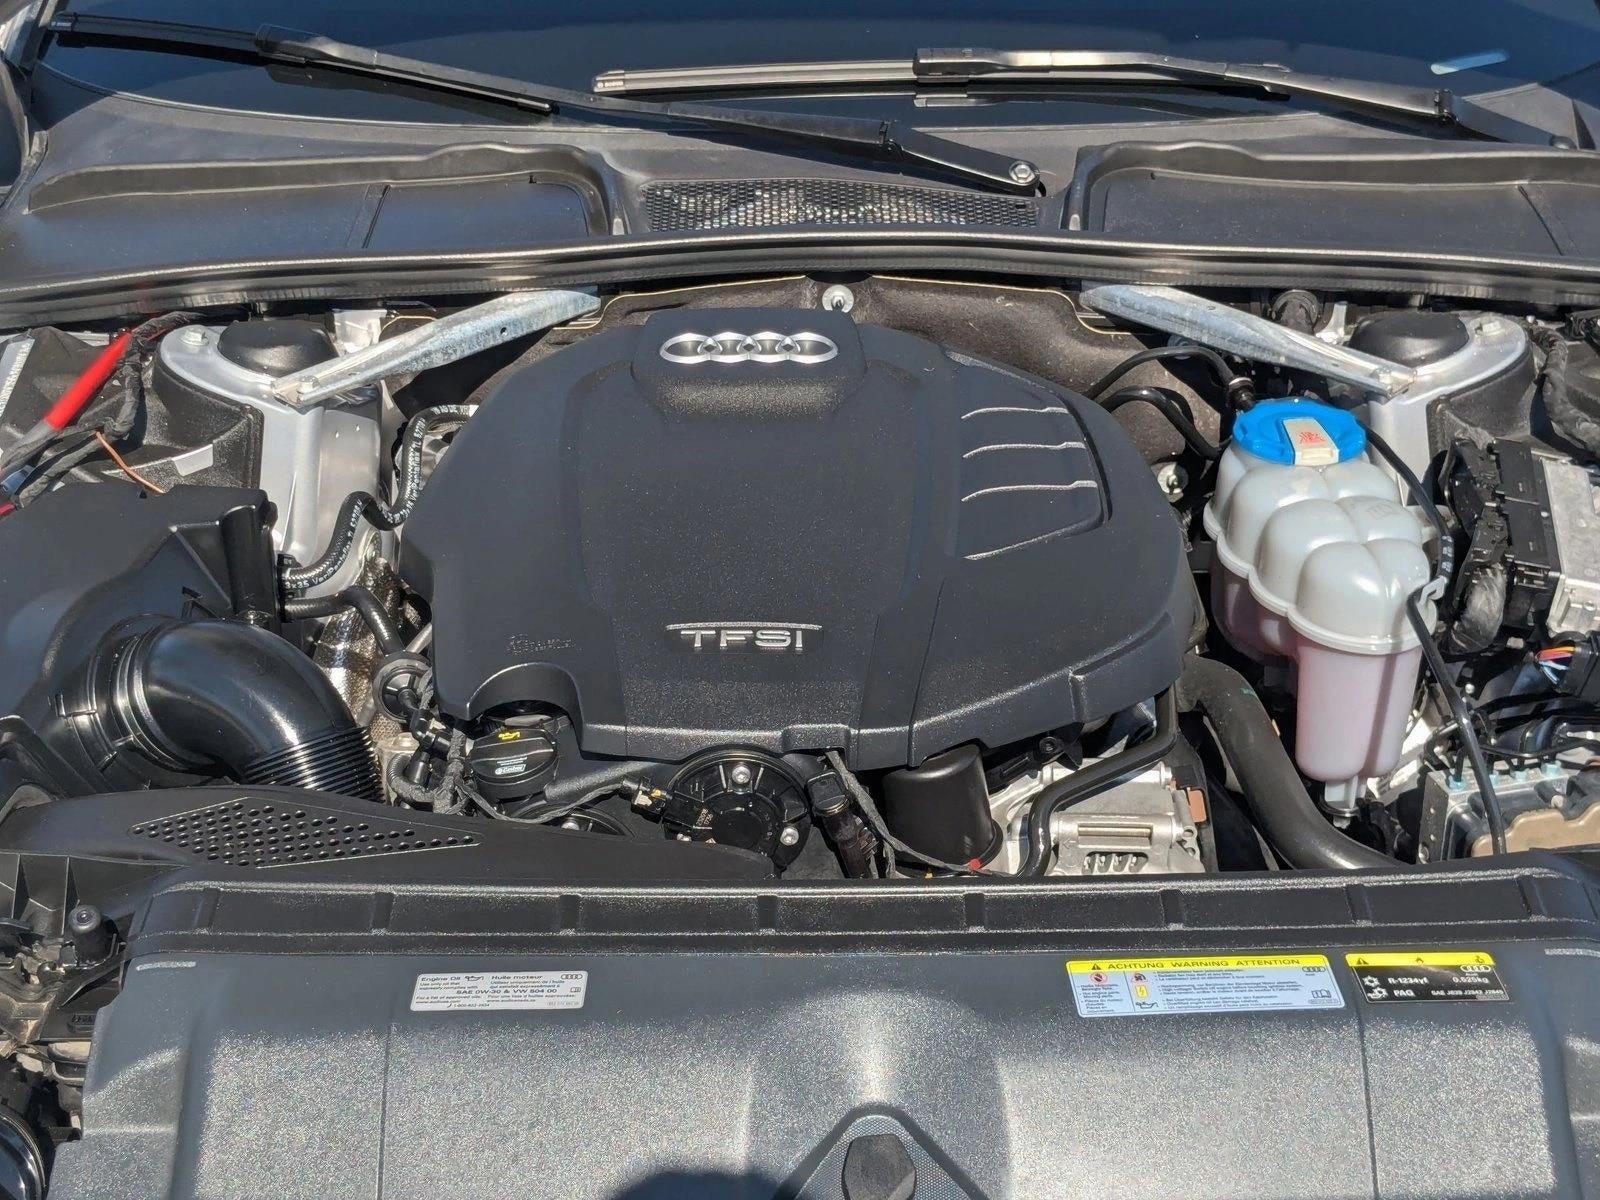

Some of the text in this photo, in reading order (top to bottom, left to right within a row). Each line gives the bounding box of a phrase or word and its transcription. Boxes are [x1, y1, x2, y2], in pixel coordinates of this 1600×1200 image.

[680, 630, 804, 651] TFSI
[1107, 962, 1165, 970] ACHTUNG
[1171, 960, 1229, 968] WARNING
